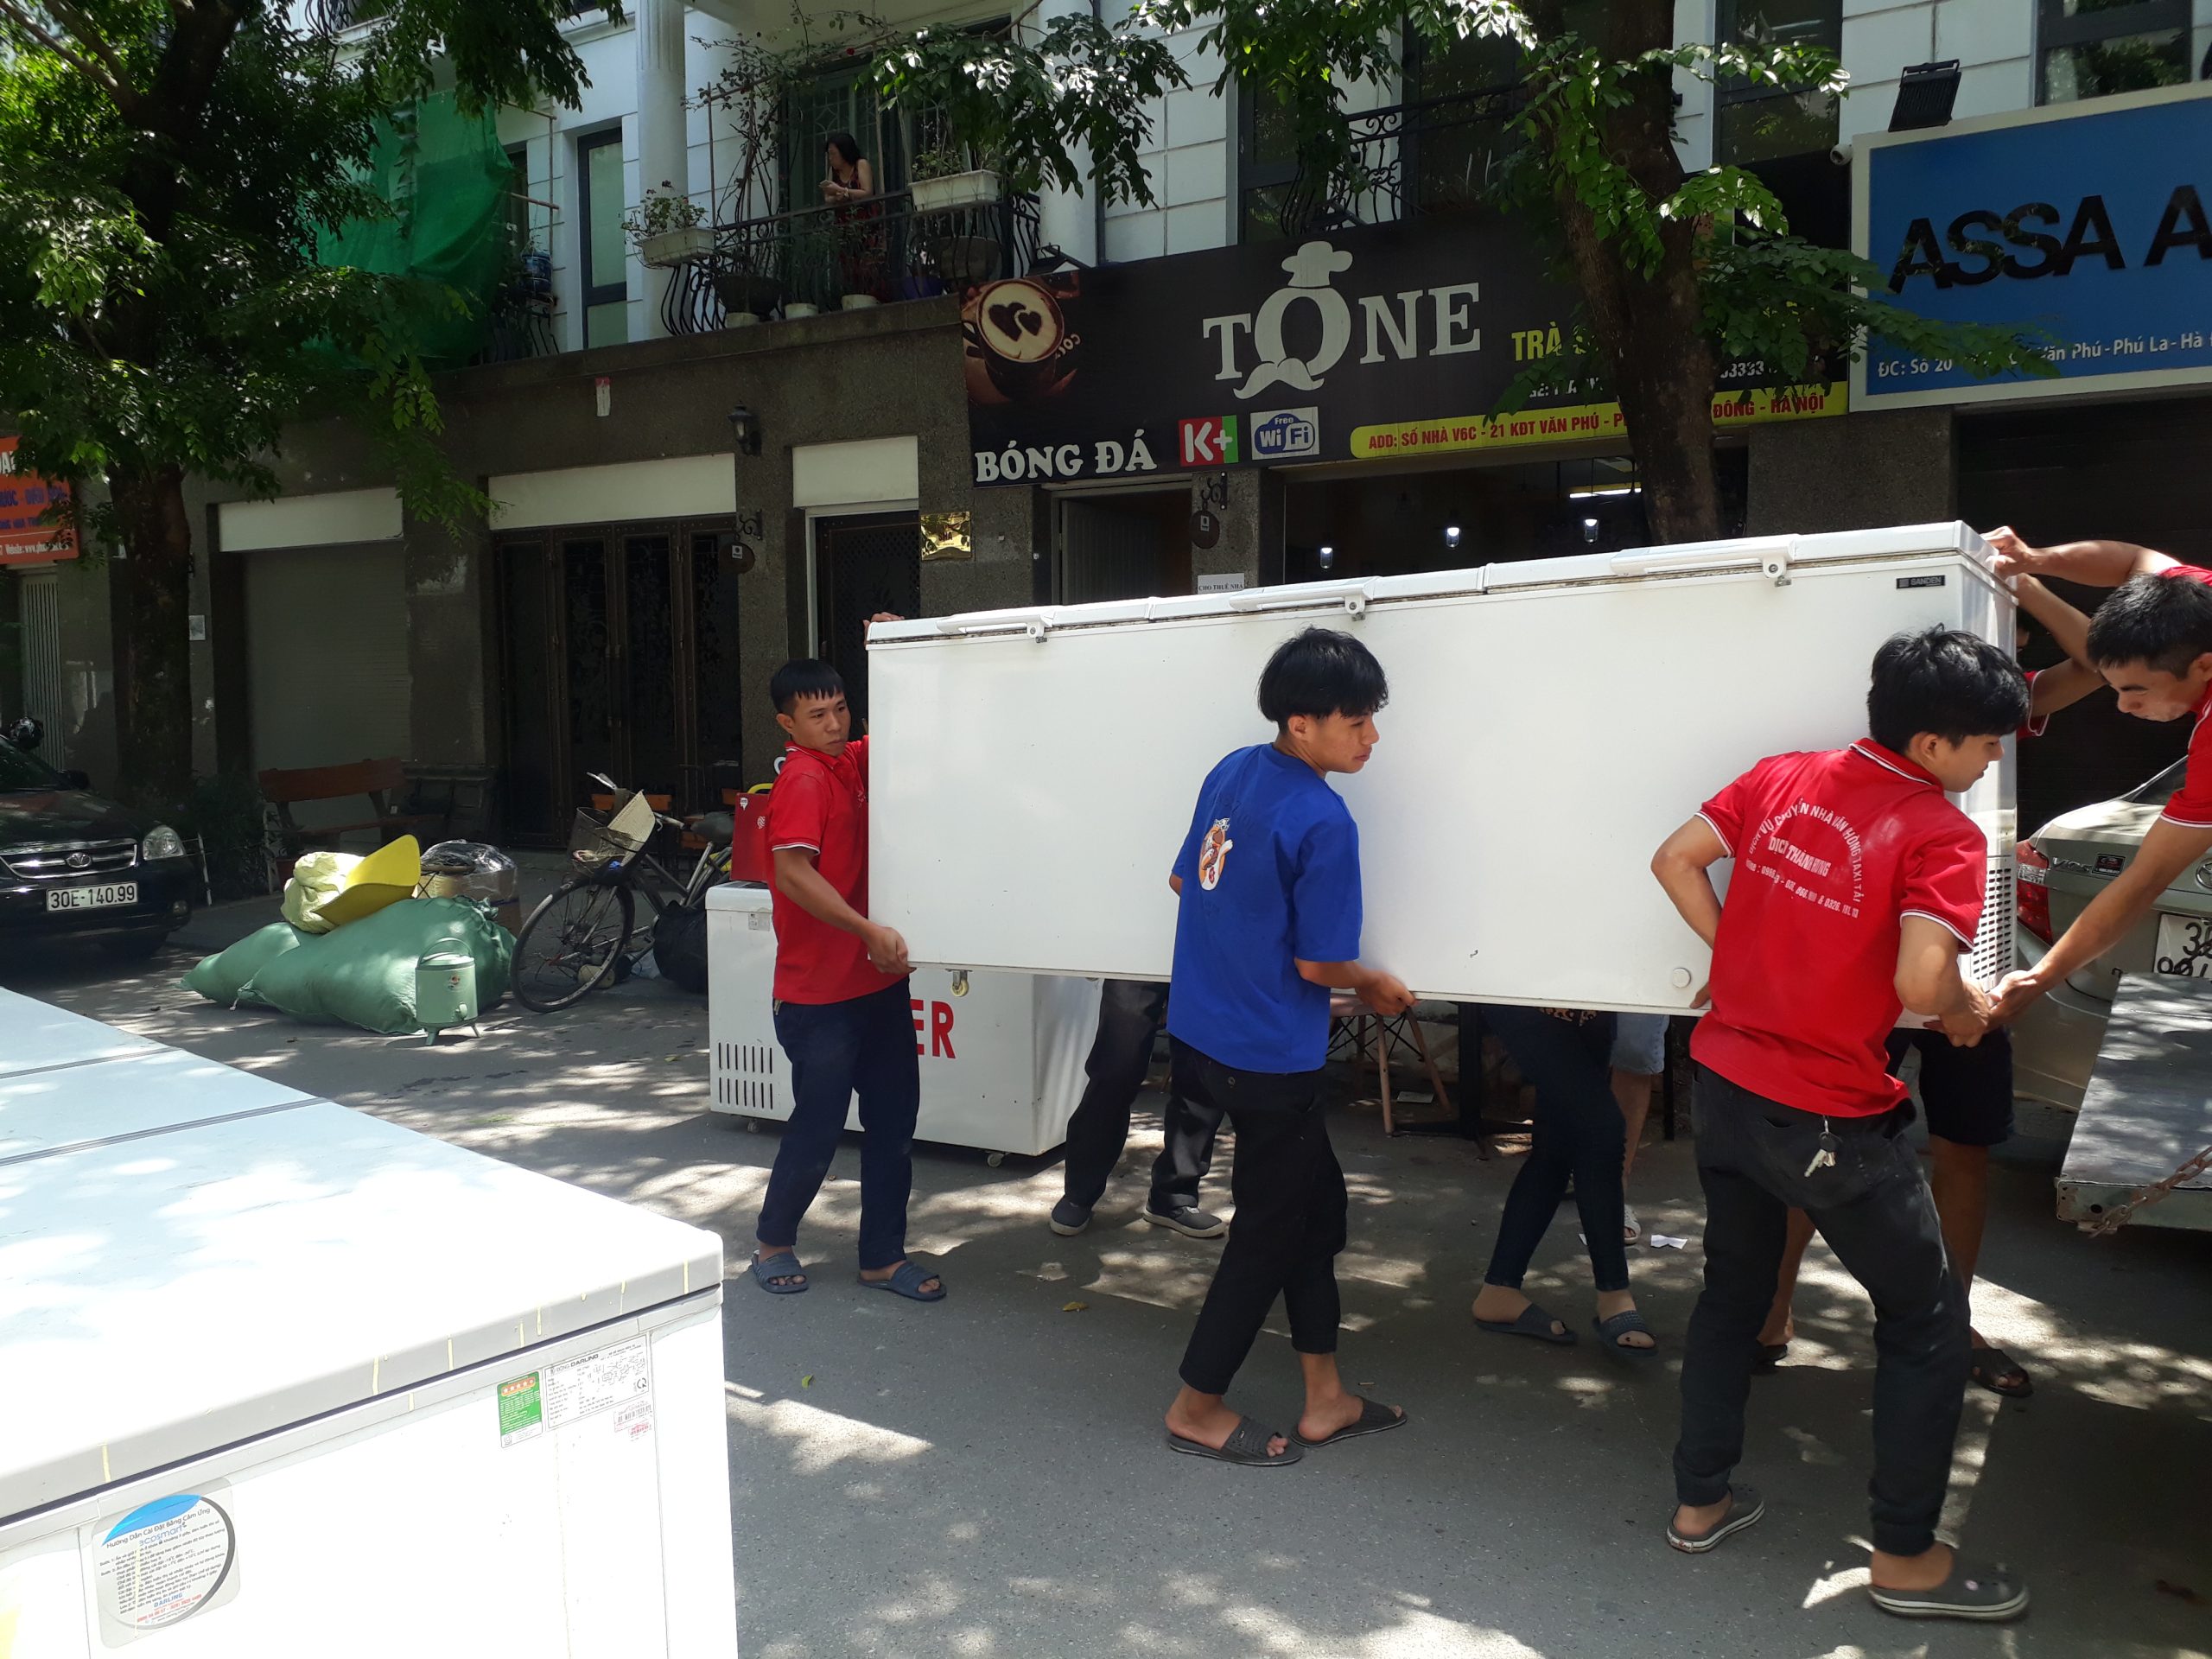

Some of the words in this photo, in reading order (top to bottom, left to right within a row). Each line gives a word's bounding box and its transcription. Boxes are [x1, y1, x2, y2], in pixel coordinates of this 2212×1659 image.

[1888, 195, 2126, 294] ASSA
[1512, 321, 1562, 361] TRÀ
[2072, 340, 2101, 359] Phú
[2113, 335, 2144, 355] Phú
[2149, 336, 2168, 352] La
[2181, 331, 2202, 349] Hà
[1274, 416, 1294, 425] Free
[1368, 433, 1398, 449] ADD:
[1402, 427, 1418, 446] SỐ
[1422, 427, 1448, 445] NHÀ
[1452, 427, 1477, 442] V6C
[1491, 424, 1504, 438] 21
[1510, 421, 1535, 436] KĐT
[1540, 416, 1567, 434] VĂN
[1572, 412, 1599, 430] PHÚ
[1713, 400, 1755, 418] ĐÔNG
[975, 441, 1084, 483] BÓNG
[1095, 429, 1157, 473] ĐÁ
[1185, 422, 1233, 463] K+
[1910, 577, 1942, 586] SANDEN
[1810, 804, 1834, 825] NHÀ
[1852, 855, 1862, 882] TAXI
[50, 885, 135, 909] 30E-140.99
